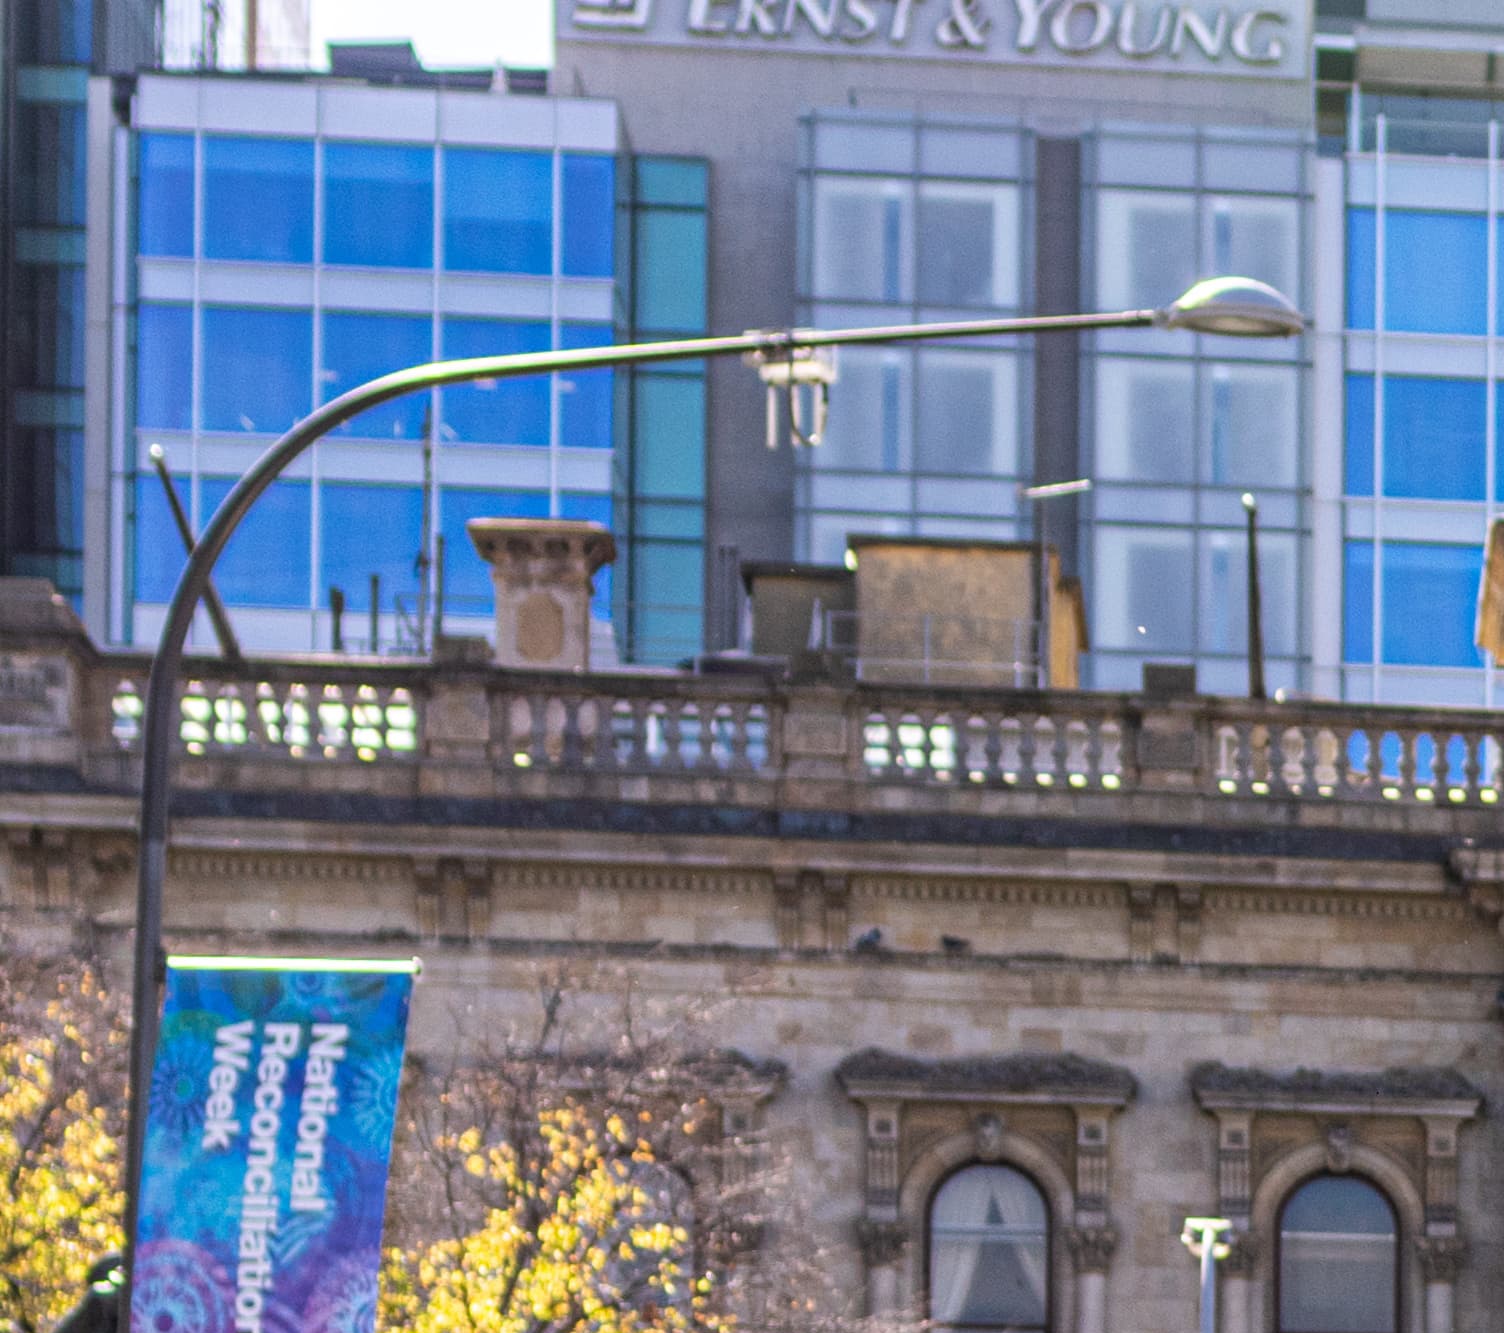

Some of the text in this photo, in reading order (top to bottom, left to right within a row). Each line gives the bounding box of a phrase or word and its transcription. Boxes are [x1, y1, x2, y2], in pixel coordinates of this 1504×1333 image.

[935, 0, 992, 50] &
[1013, 0, 1285, 63] YOUNG
[202, 1019, 254, 1150] Week
[290, 1022, 349, 1213] National
